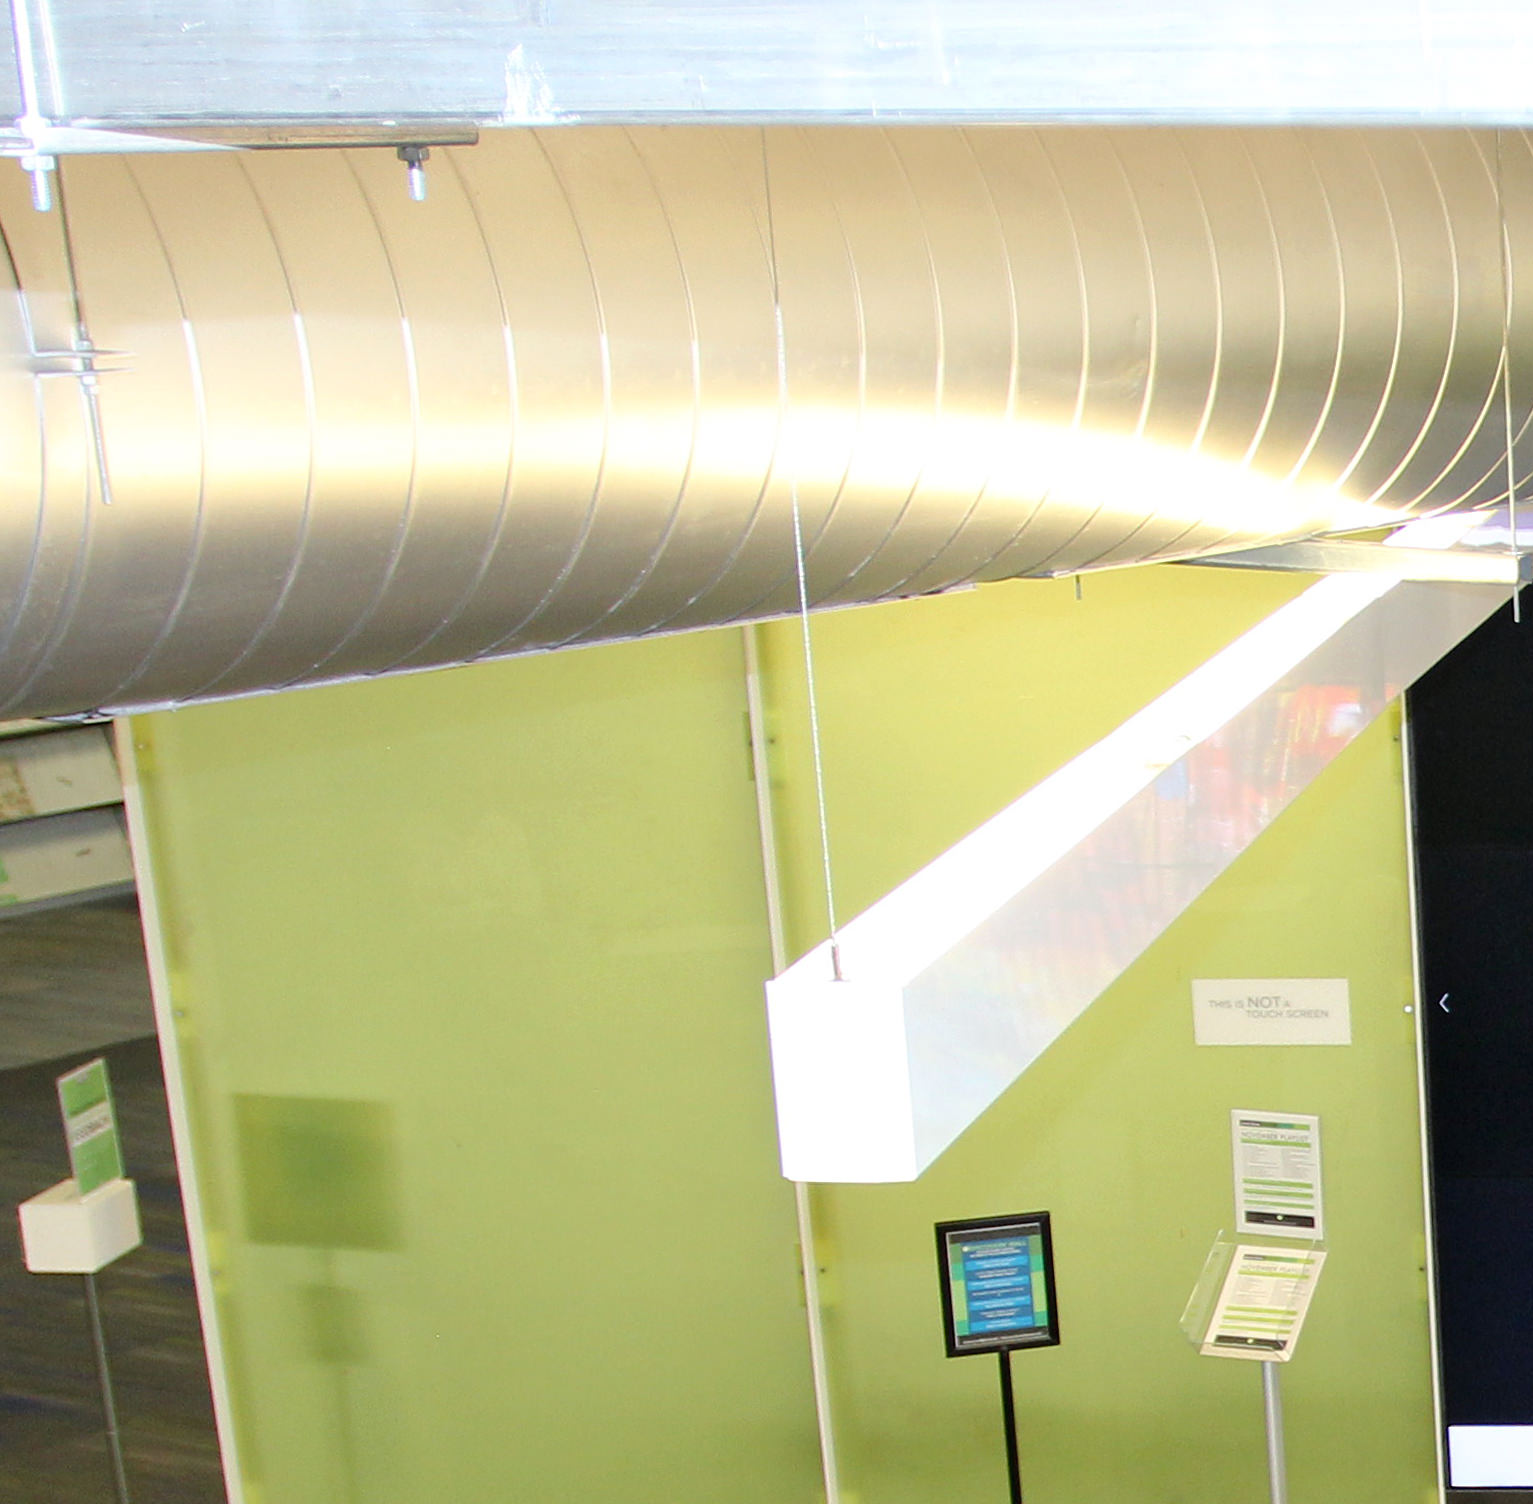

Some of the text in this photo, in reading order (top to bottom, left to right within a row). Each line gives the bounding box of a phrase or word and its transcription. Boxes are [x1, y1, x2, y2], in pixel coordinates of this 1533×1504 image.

[1208, 1000, 1233, 1009] THIS
[1234, 1000, 1245, 1009] IS
[1247, 996, 1281, 1009] NOT
[1246, 1009, 1329, 1018] TOUCH SCREEN
